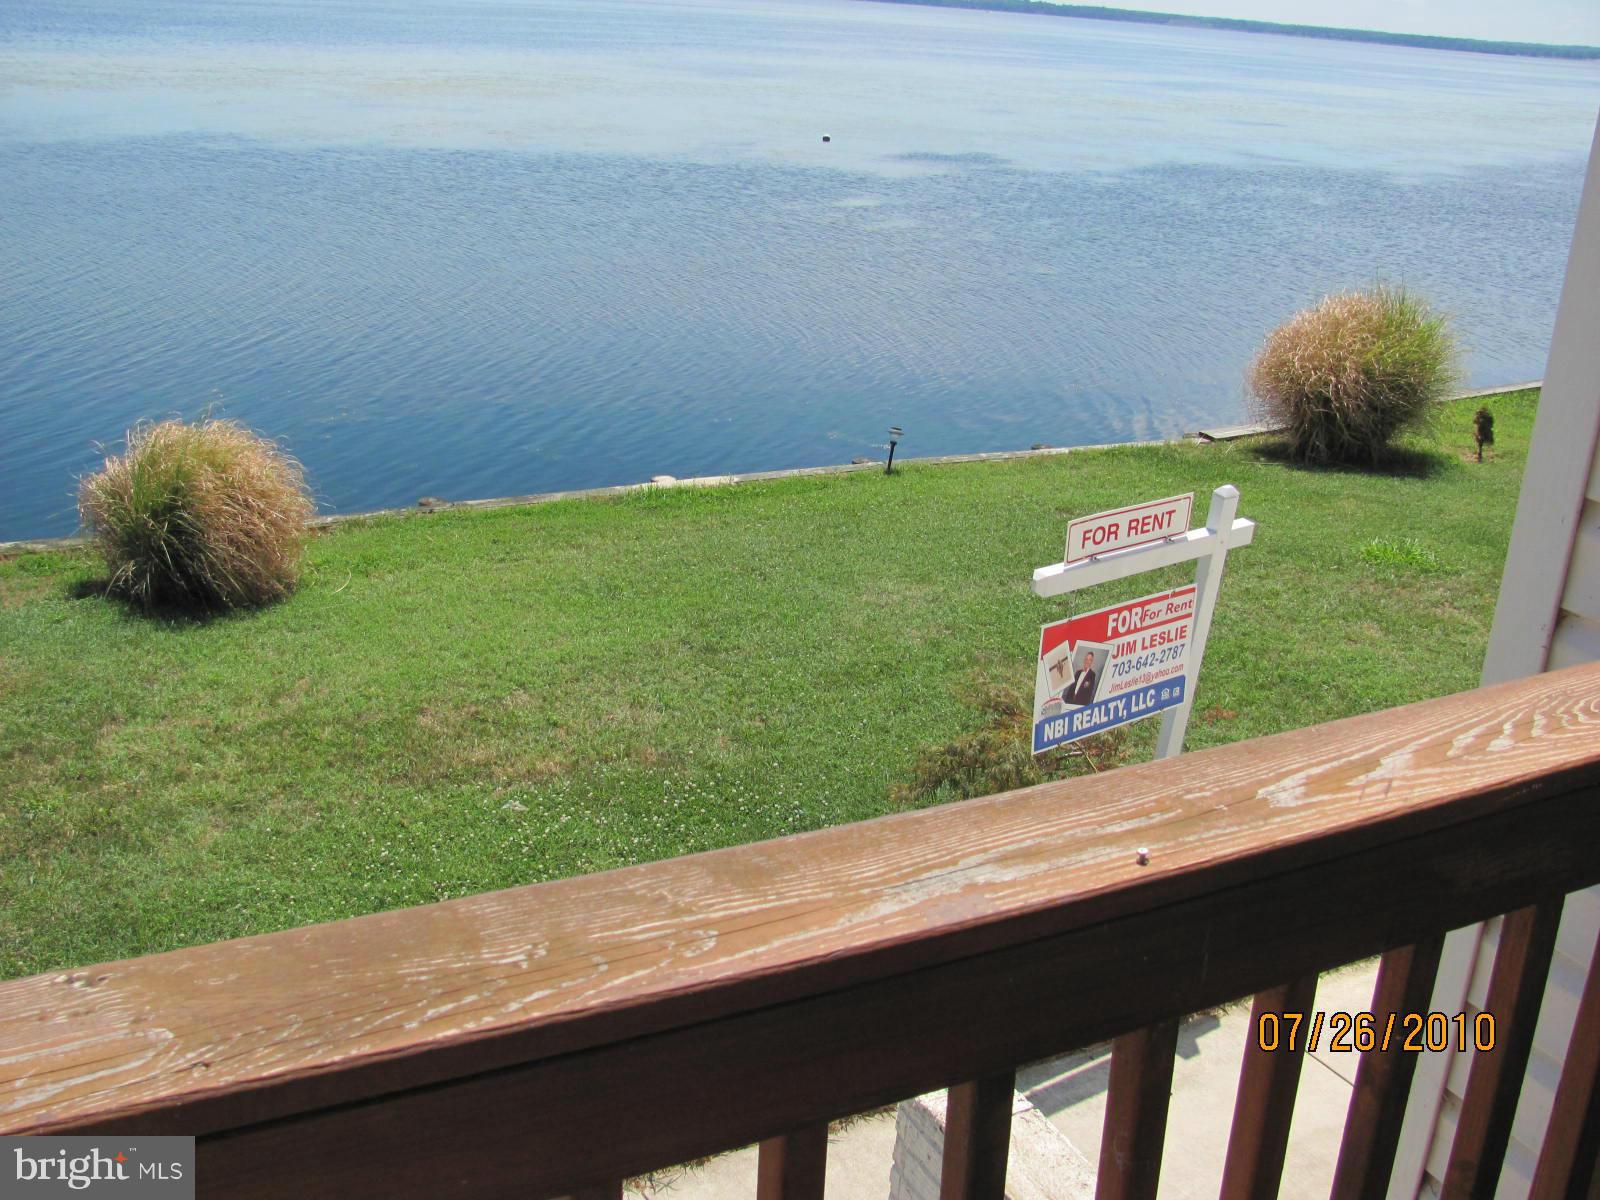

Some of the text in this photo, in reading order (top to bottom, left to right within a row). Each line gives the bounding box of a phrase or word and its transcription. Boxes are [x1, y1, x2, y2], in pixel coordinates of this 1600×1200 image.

[1081, 509, 1176, 549] FOR RENT
[1107, 607, 1142, 637] FOR
[1143, 600, 1193, 622] For Rent
[1112, 625, 1187, 660] JIM LESLIE
[1112, 643, 1186, 678] 703-642-2787
[1044, 717, 1068, 742] NBI
[1072, 698, 1127, 733] REALTY,
[1131, 689, 1156, 713] LLC
